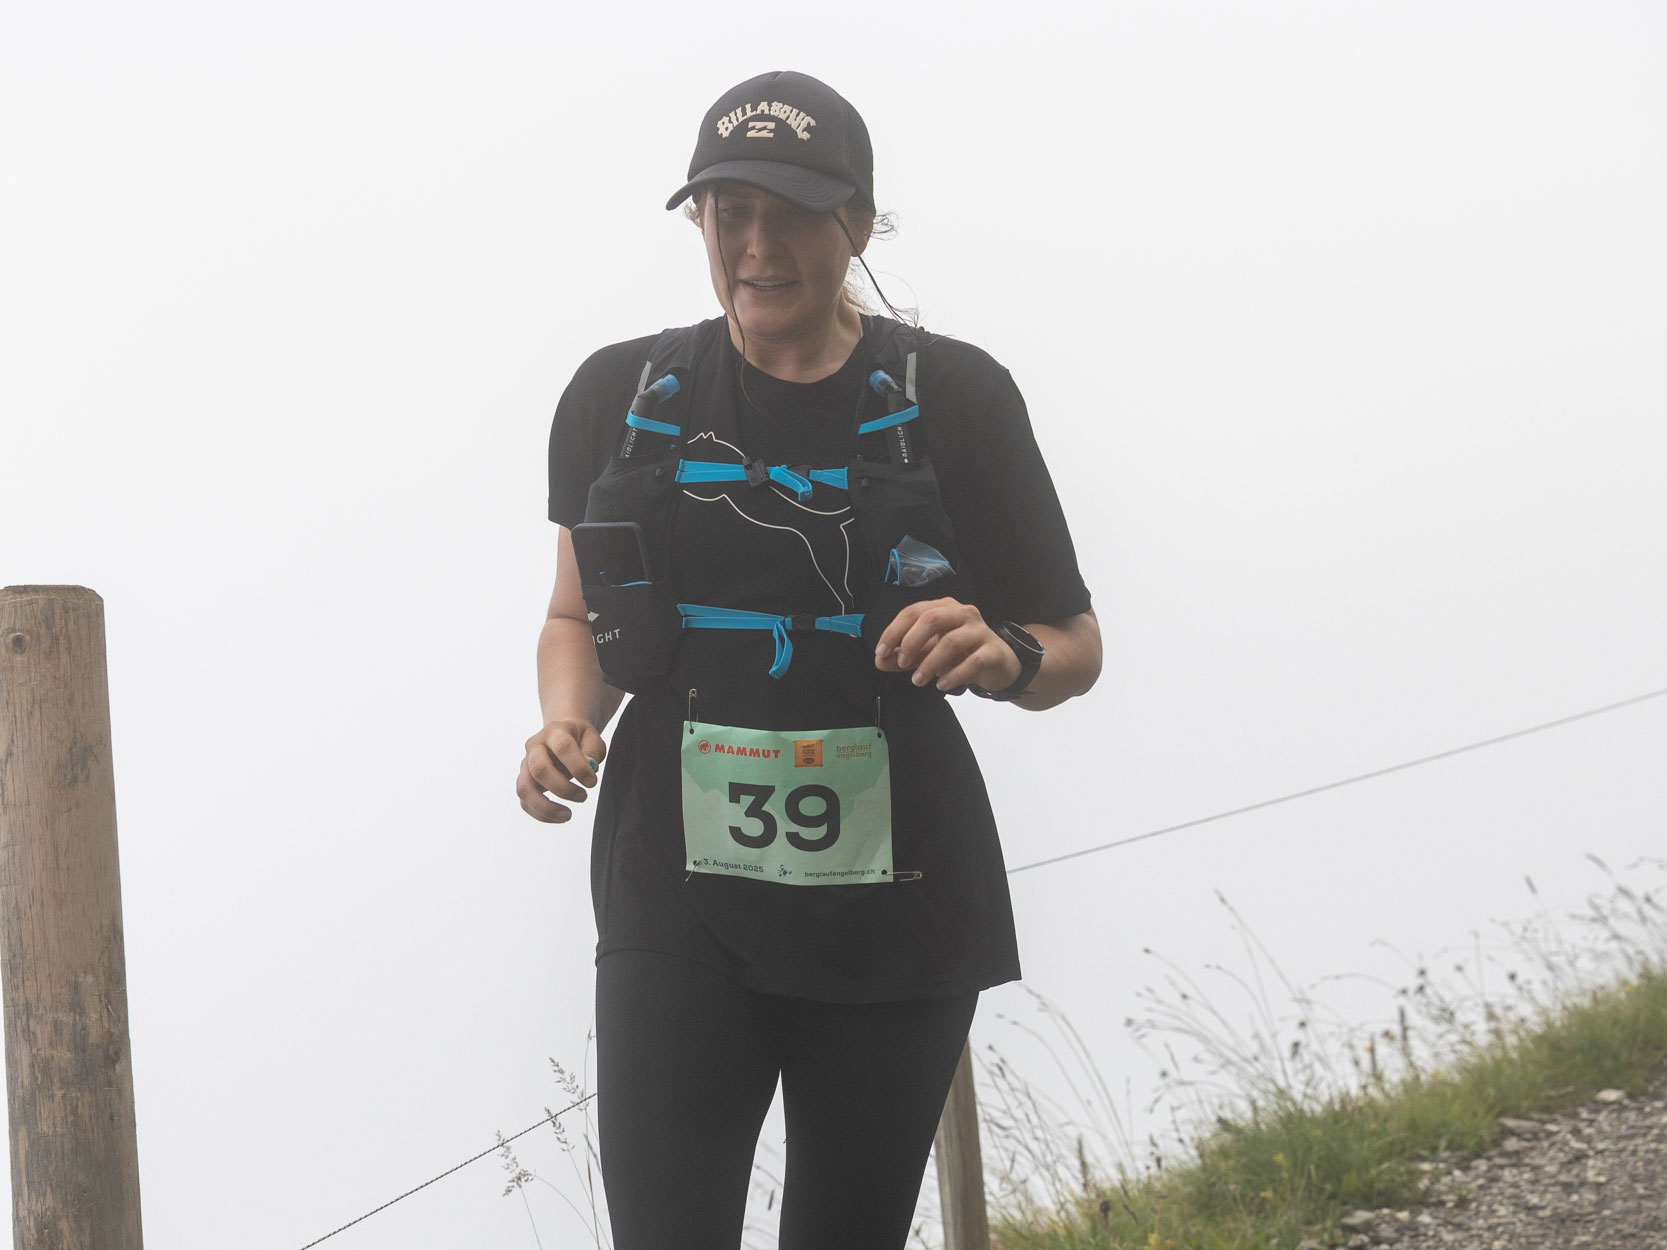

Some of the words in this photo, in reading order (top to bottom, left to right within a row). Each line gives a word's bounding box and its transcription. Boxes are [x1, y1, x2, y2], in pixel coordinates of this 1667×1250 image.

[716, 100, 817, 141] BILLABONG
[896, 423, 908, 458] RAIDLIGH
[714, 743, 781, 759] MAMMUT
[836, 742, 873, 753] berglauf
[836, 750, 873, 760] engelberg
[728, 781, 841, 853] 39
[703, 858, 712, 866] 3.
[713, 859, 742, 870] August
[742, 863, 765, 873] 2025
[804, 868, 876, 879] berglaufengelberg.ch
